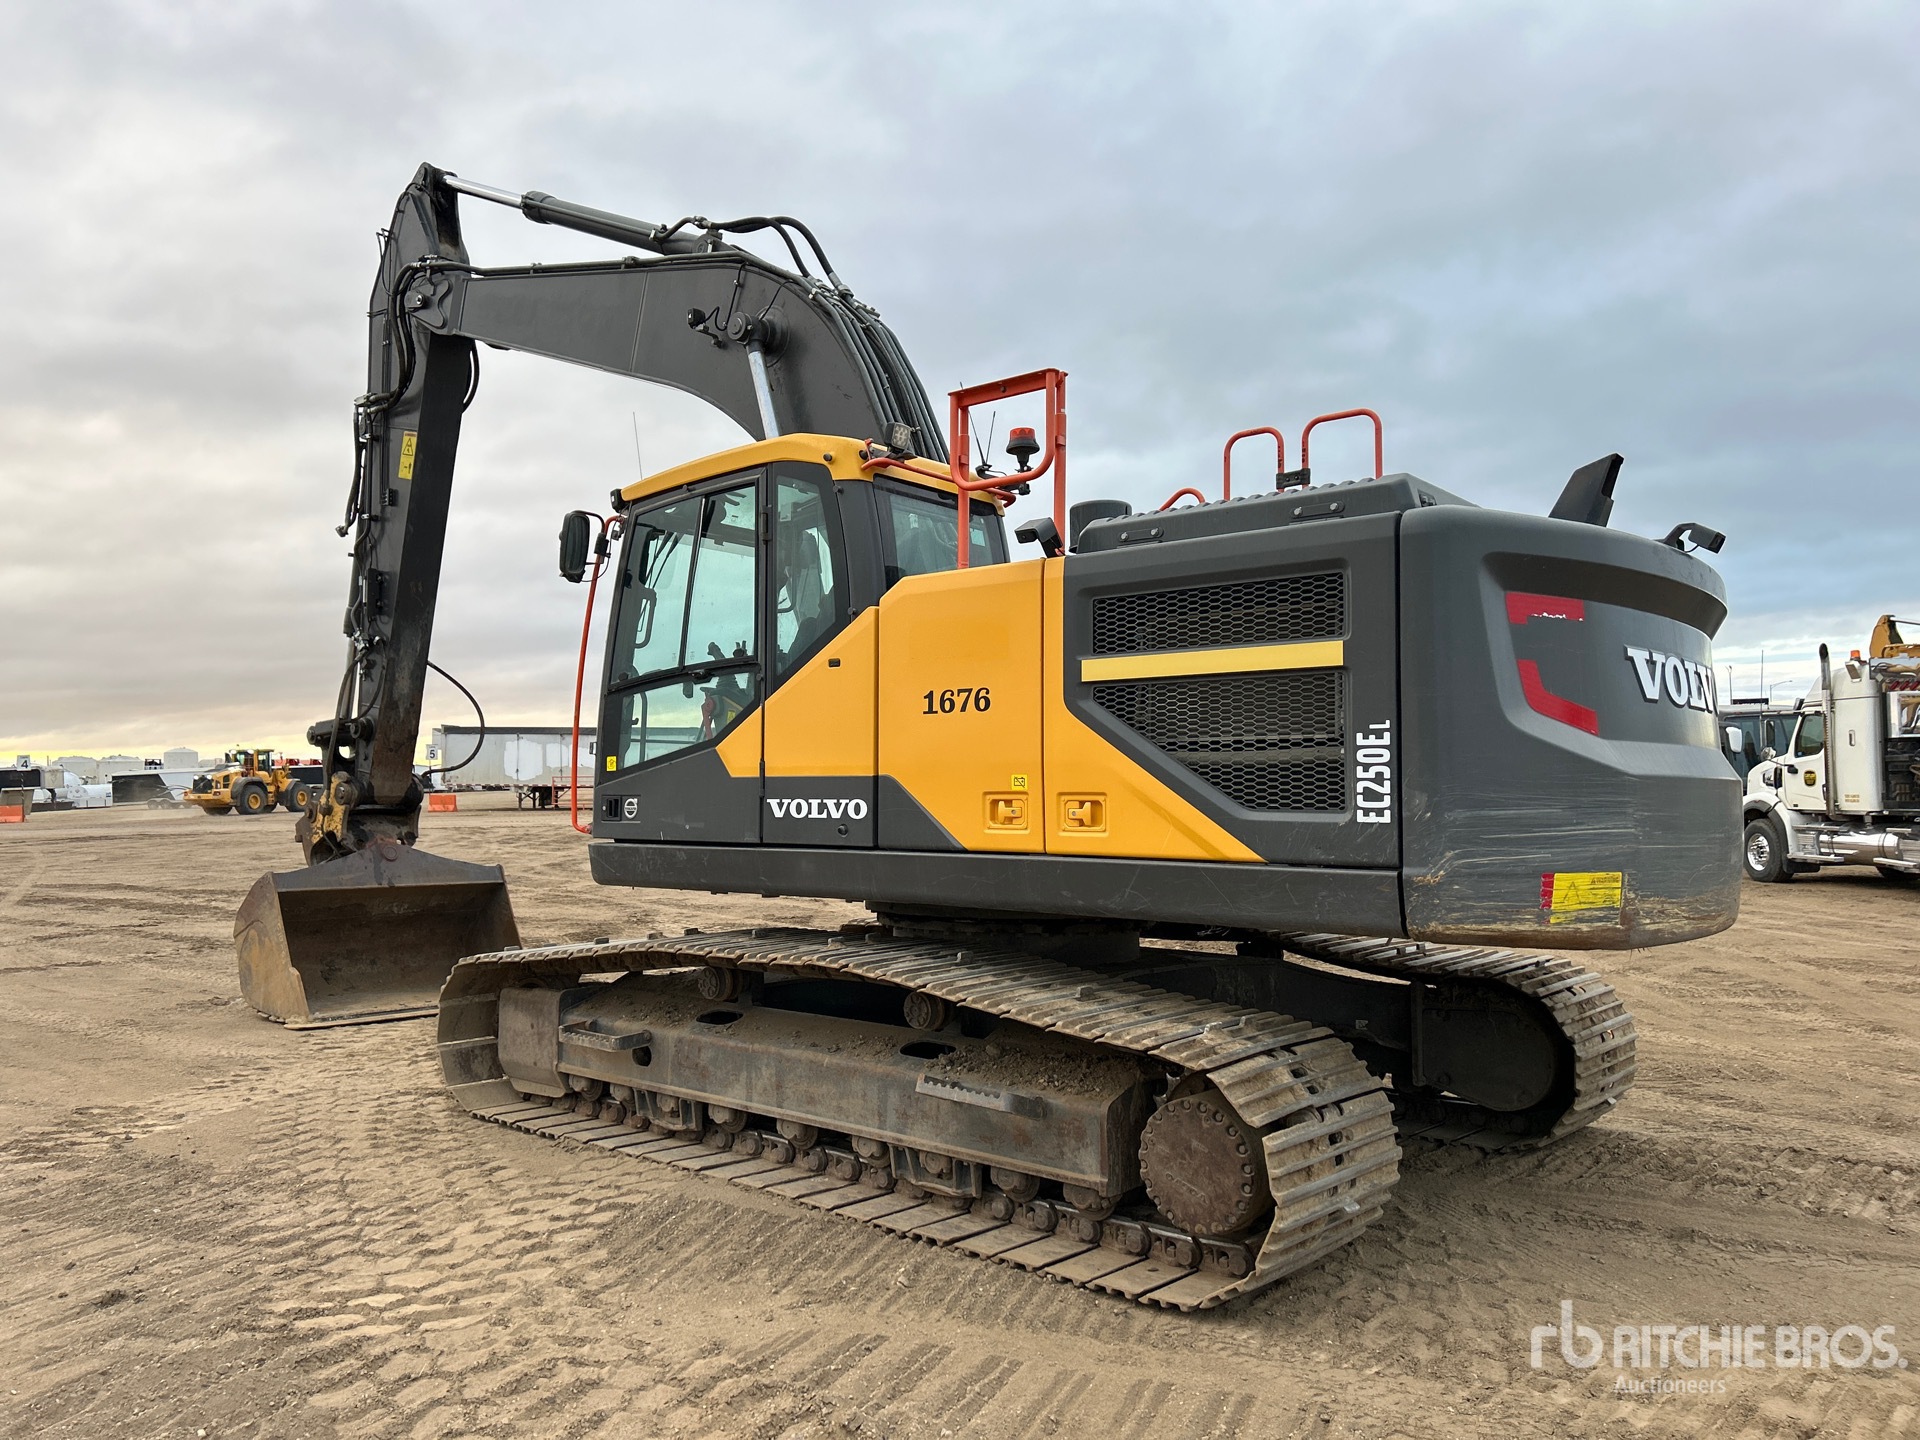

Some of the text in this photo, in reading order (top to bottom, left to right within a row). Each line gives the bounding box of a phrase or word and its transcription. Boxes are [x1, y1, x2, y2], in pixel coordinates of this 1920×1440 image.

[1624, 645, 1719, 716] VOLV
[923, 687, 991, 714] 1676
[21, 760, 28, 769] 4
[430, 750, 435, 759] 5
[766, 798, 868, 820] VOLVO
